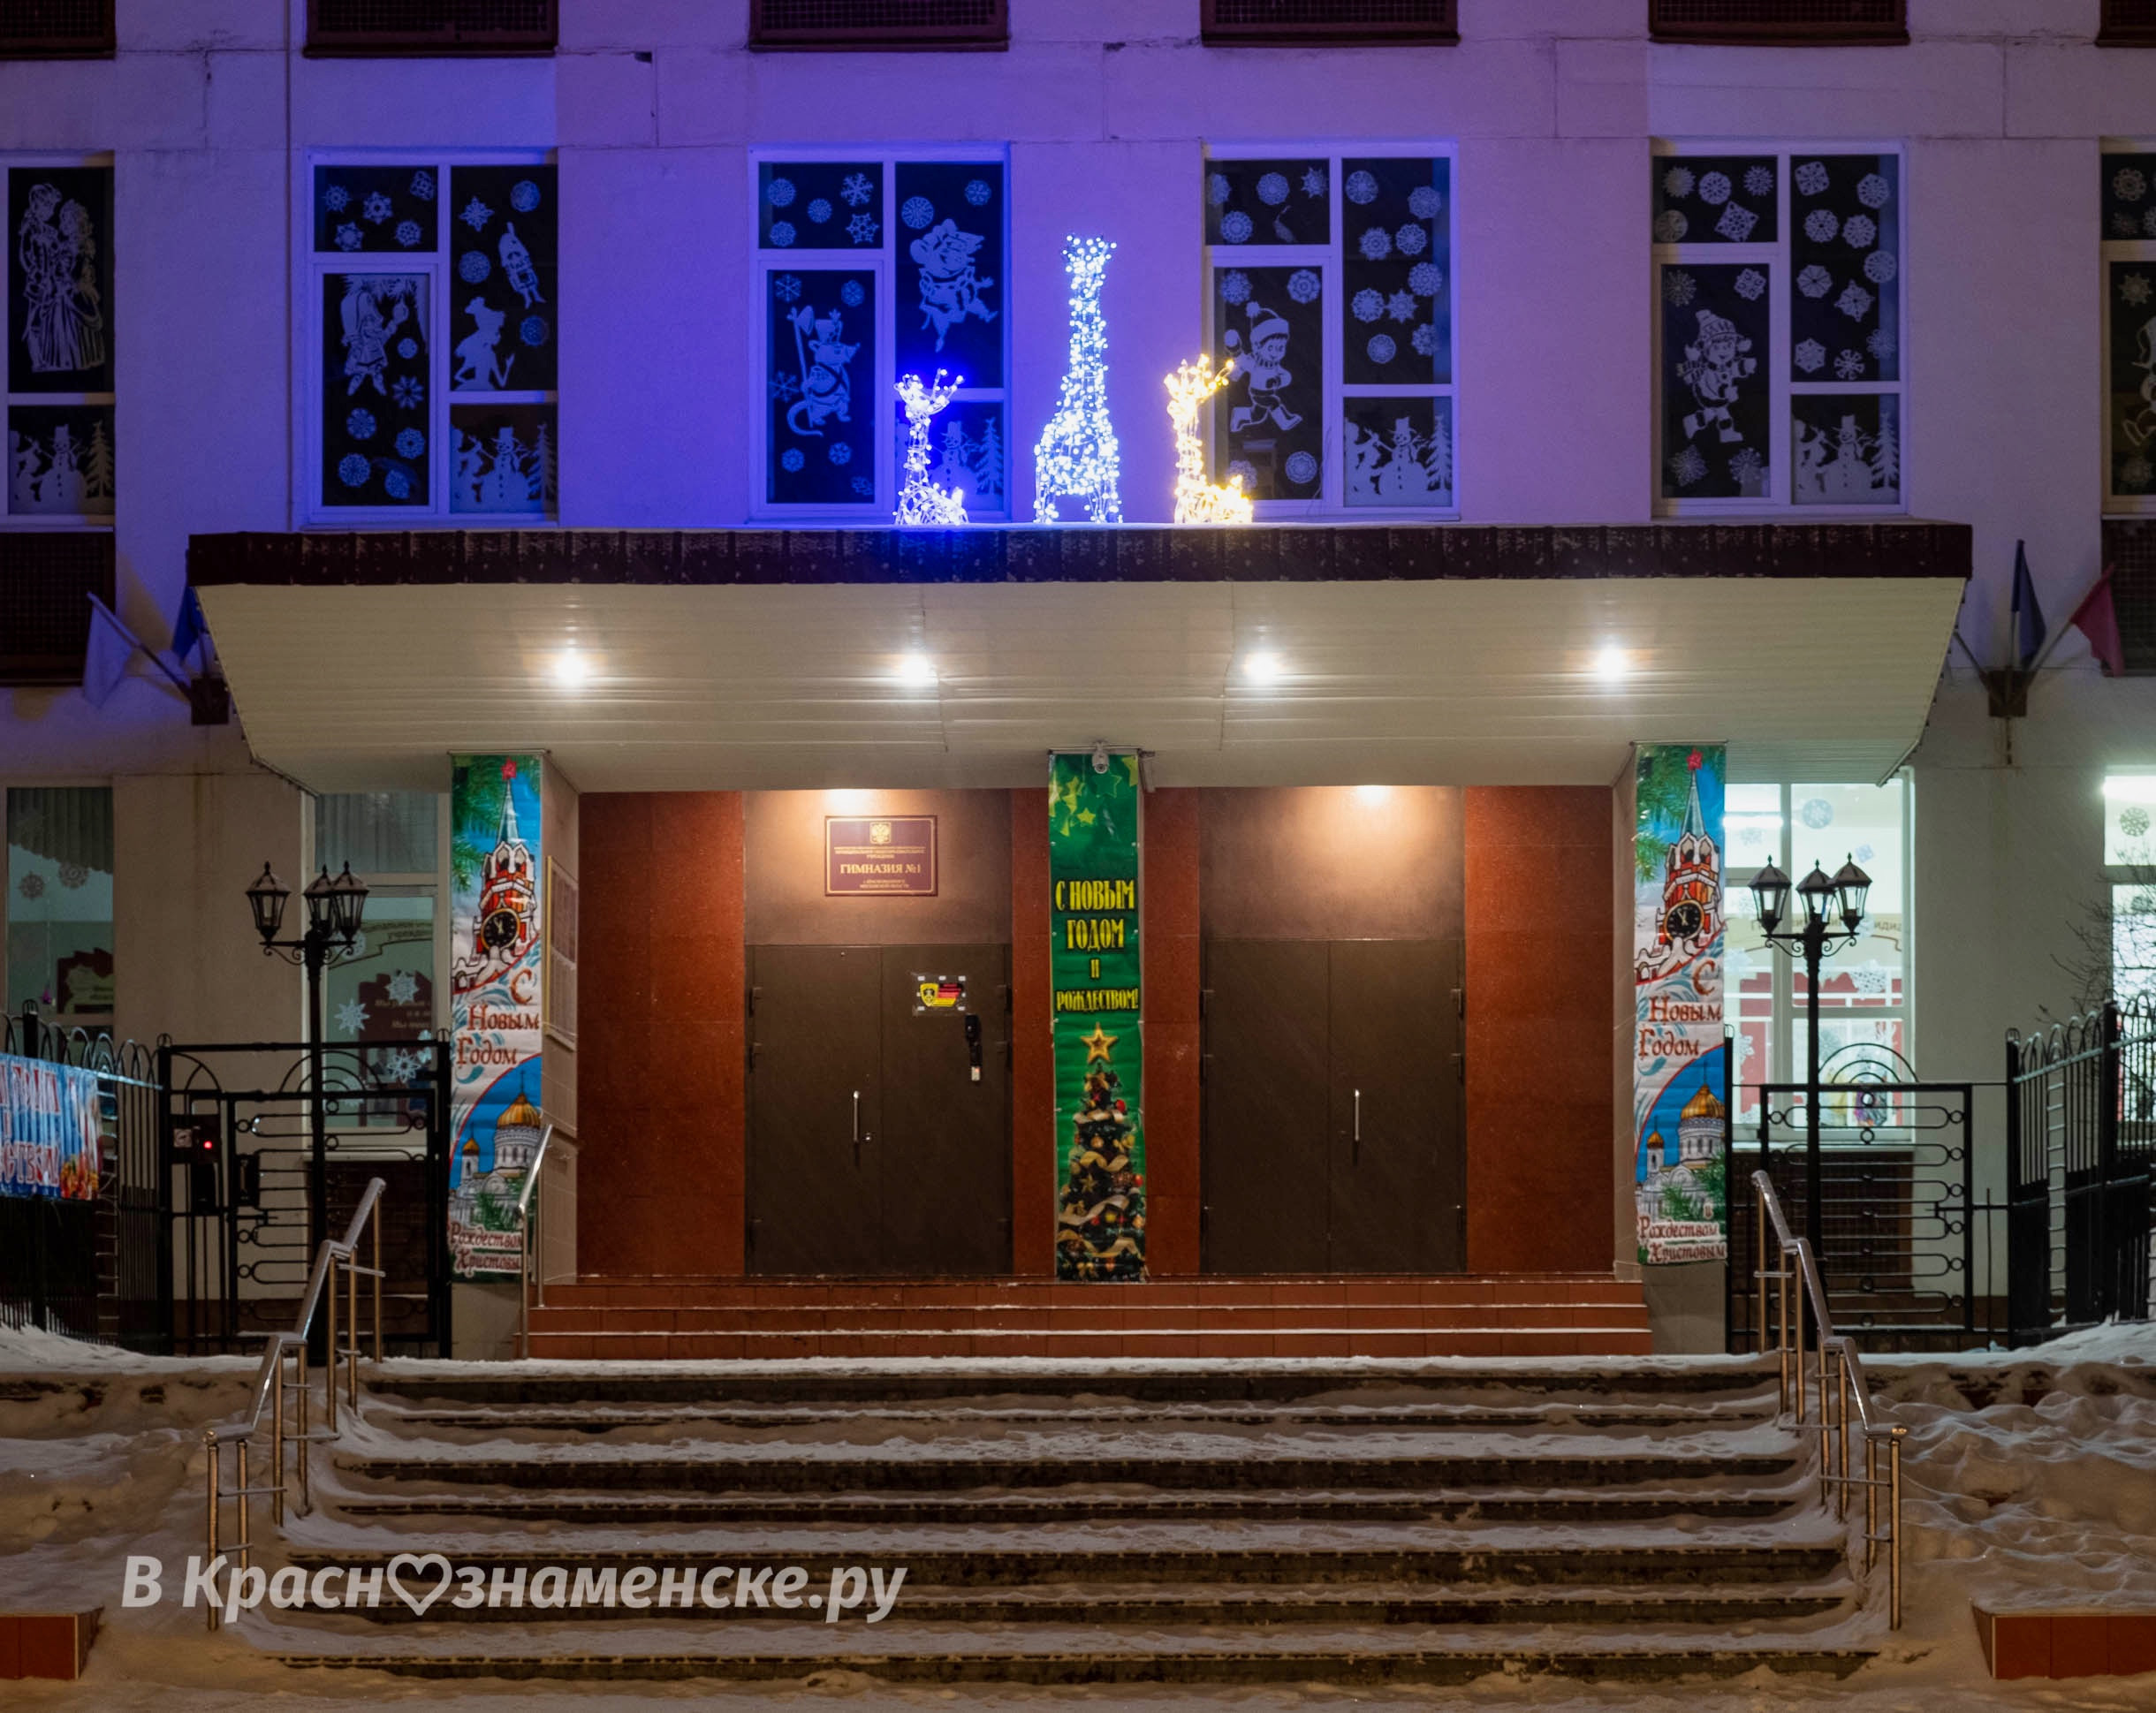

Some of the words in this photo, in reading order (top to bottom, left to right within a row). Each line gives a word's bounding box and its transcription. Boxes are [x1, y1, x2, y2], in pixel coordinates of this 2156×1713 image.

[840, 864, 903, 874] ГИМНАЗИЯ
[1055, 881, 1066, 911] С
[1069, 880, 1135, 910] НОВЫМ
[1067, 919, 1124, 951] ГОДОМ
[511, 968, 532, 1004] С
[1693, 959, 1715, 996] С
[1056, 988, 1139, 1012] РОЖДЕСТВОМ!
[1648, 994, 1721, 1025] Новым
[467, 1003, 539, 1031] Новым
[456, 1035, 517, 1065] Годом
[1638, 1025, 1699, 1059] Годом
